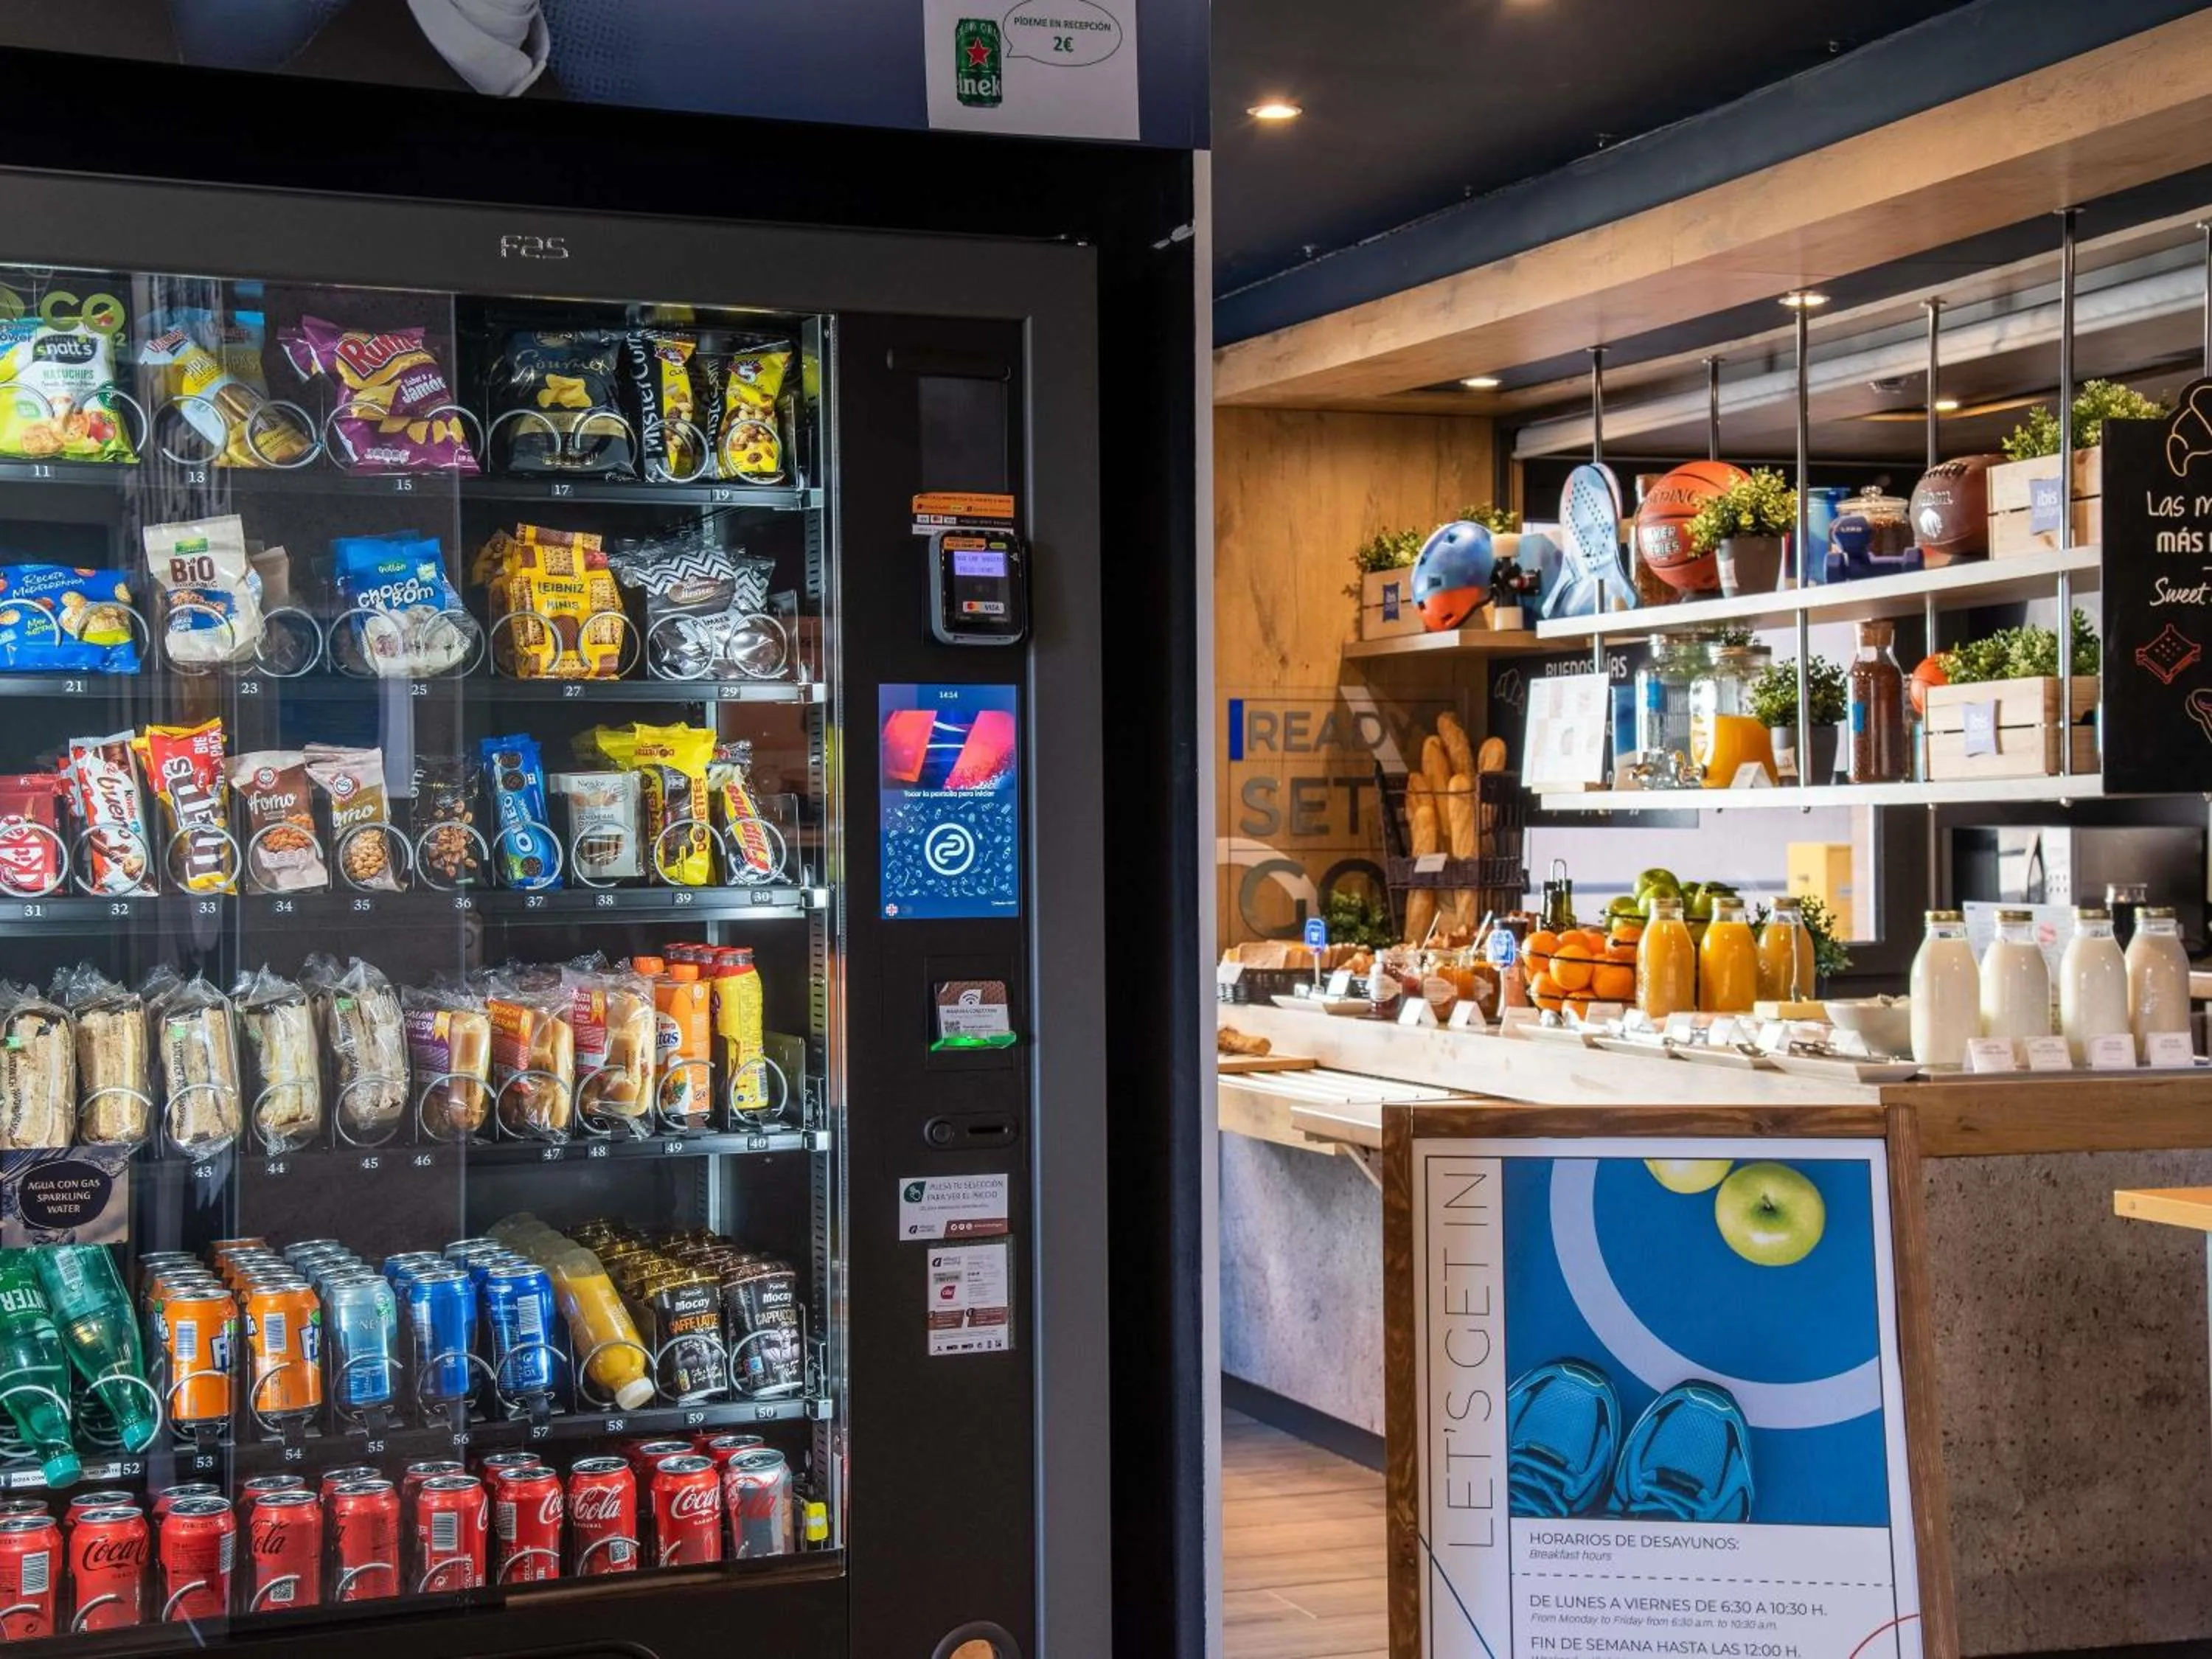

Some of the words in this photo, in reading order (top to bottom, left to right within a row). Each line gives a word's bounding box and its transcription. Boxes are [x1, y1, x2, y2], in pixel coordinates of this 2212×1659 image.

[1049, 18, 1061, 28] EN
[1063, 19, 1111, 31] RECEPCIÓN
[1053, 36, 1074, 52] 2€
[35, 466, 50, 478] 11
[187, 472, 206, 483] 13
[397, 479, 412, 490] 15
[554, 484, 568, 495] 17
[714, 489, 730, 501] 19
[2146, 490, 2185, 517] Las
[2156, 527, 2204, 554] MÁS
[537, 580, 585, 596] LEIBNIZ
[2149, 576, 2207, 608] Sweet
[65, 681, 83, 693] 21
[241, 682, 258, 695] 23
[411, 684, 428, 696] 25
[565, 686, 582, 698] 27
[722, 686, 739, 698] 29
[1240, 776, 1377, 837] SET
[527, 896, 544, 908] 37
[597, 894, 614, 906] 38
[675, 892, 692, 904] 39
[753, 891, 770, 902] 30
[111, 903, 129, 915] 32
[198, 902, 216, 914] 33
[275, 900, 293, 912] 34
[354, 899, 371, 910] 35
[455, 897, 472, 909] 36
[24, 904, 42, 917] 31
[667, 1142, 683, 1154] 49
[749, 1138, 767, 1149] 40
[543, 1148, 561, 1160] 47
[590, 1147, 607, 1158] 48
[362, 1157, 379, 1168] 45
[414, 1155, 431, 1166] 46
[195, 1166, 212, 1178] 43
[267, 1163, 286, 1174] 44
[27, 1180, 55, 1191] AGUA
[57, 1180, 80, 1190] CON
[81, 1178, 100, 1189] GAS
[35, 1191, 91, 1203] SPARKLING
[1444, 1172, 1488, 1227] IN
[46, 1203, 81, 1215] WATER
[1444, 1248, 1491, 1368] GET
[757, 1407, 774, 1418] 50
[607, 1419, 624, 1431] 58
[688, 1413, 704, 1425] 59
[532, 1426, 549, 1439] 57
[453, 1433, 470, 1445] 56
[368, 1441, 385, 1453] 55
[285, 1448, 302, 1460] 54
[195, 1456, 214, 1468] 53
[122, 1462, 141, 1475] 52
[1443, 1389, 1495, 1548] LET'S
[1529, 1532, 1612, 1546] HORARIOS
[1615, 1534, 1638, 1547] DE
[1641, 1535, 1740, 1551] DESAYUNOS:
[1528, 1548, 1580, 1560] Breakfast
[1582, 1550, 1612, 1561] hours
[1529, 1594, 1551, 1607] DE
[1555, 1595, 1607, 1609] LUNES
[1610, 1597, 1621, 1610] A
[1624, 1597, 1691, 1612] VIERNES
[1695, 1599, 1719, 1613] DE
[1720, 1601, 1751, 1614] 6:30
[1755, 1602, 1767, 1614] A
[1769, 1602, 1807, 1615] 10:30
[1811, 1604, 1828, 1617] H.
[1530, 1613, 1557, 1623] From
[1559, 1614, 1598, 1625] Monday
[1601, 1615, 1610, 1625] to
[1613, 1615, 1644, 1627] Friday
[1645, 1616, 1669, 1627] from
[1671, 1617, 1694, 1627] 6:30
[1717, 1619, 1728, 1629] to
[1530, 1635, 1556, 1650] FIN
[1560, 1637, 1583, 1651] DE
[1585, 1638, 1654, 1653] SEMANA
[1657, 1641, 1708, 1655] HASTA
[1711, 1642, 1741, 1656] LAS
[1744, 1643, 1782, 1657] 12:00
[1785, 1644, 1803, 1658] H.
